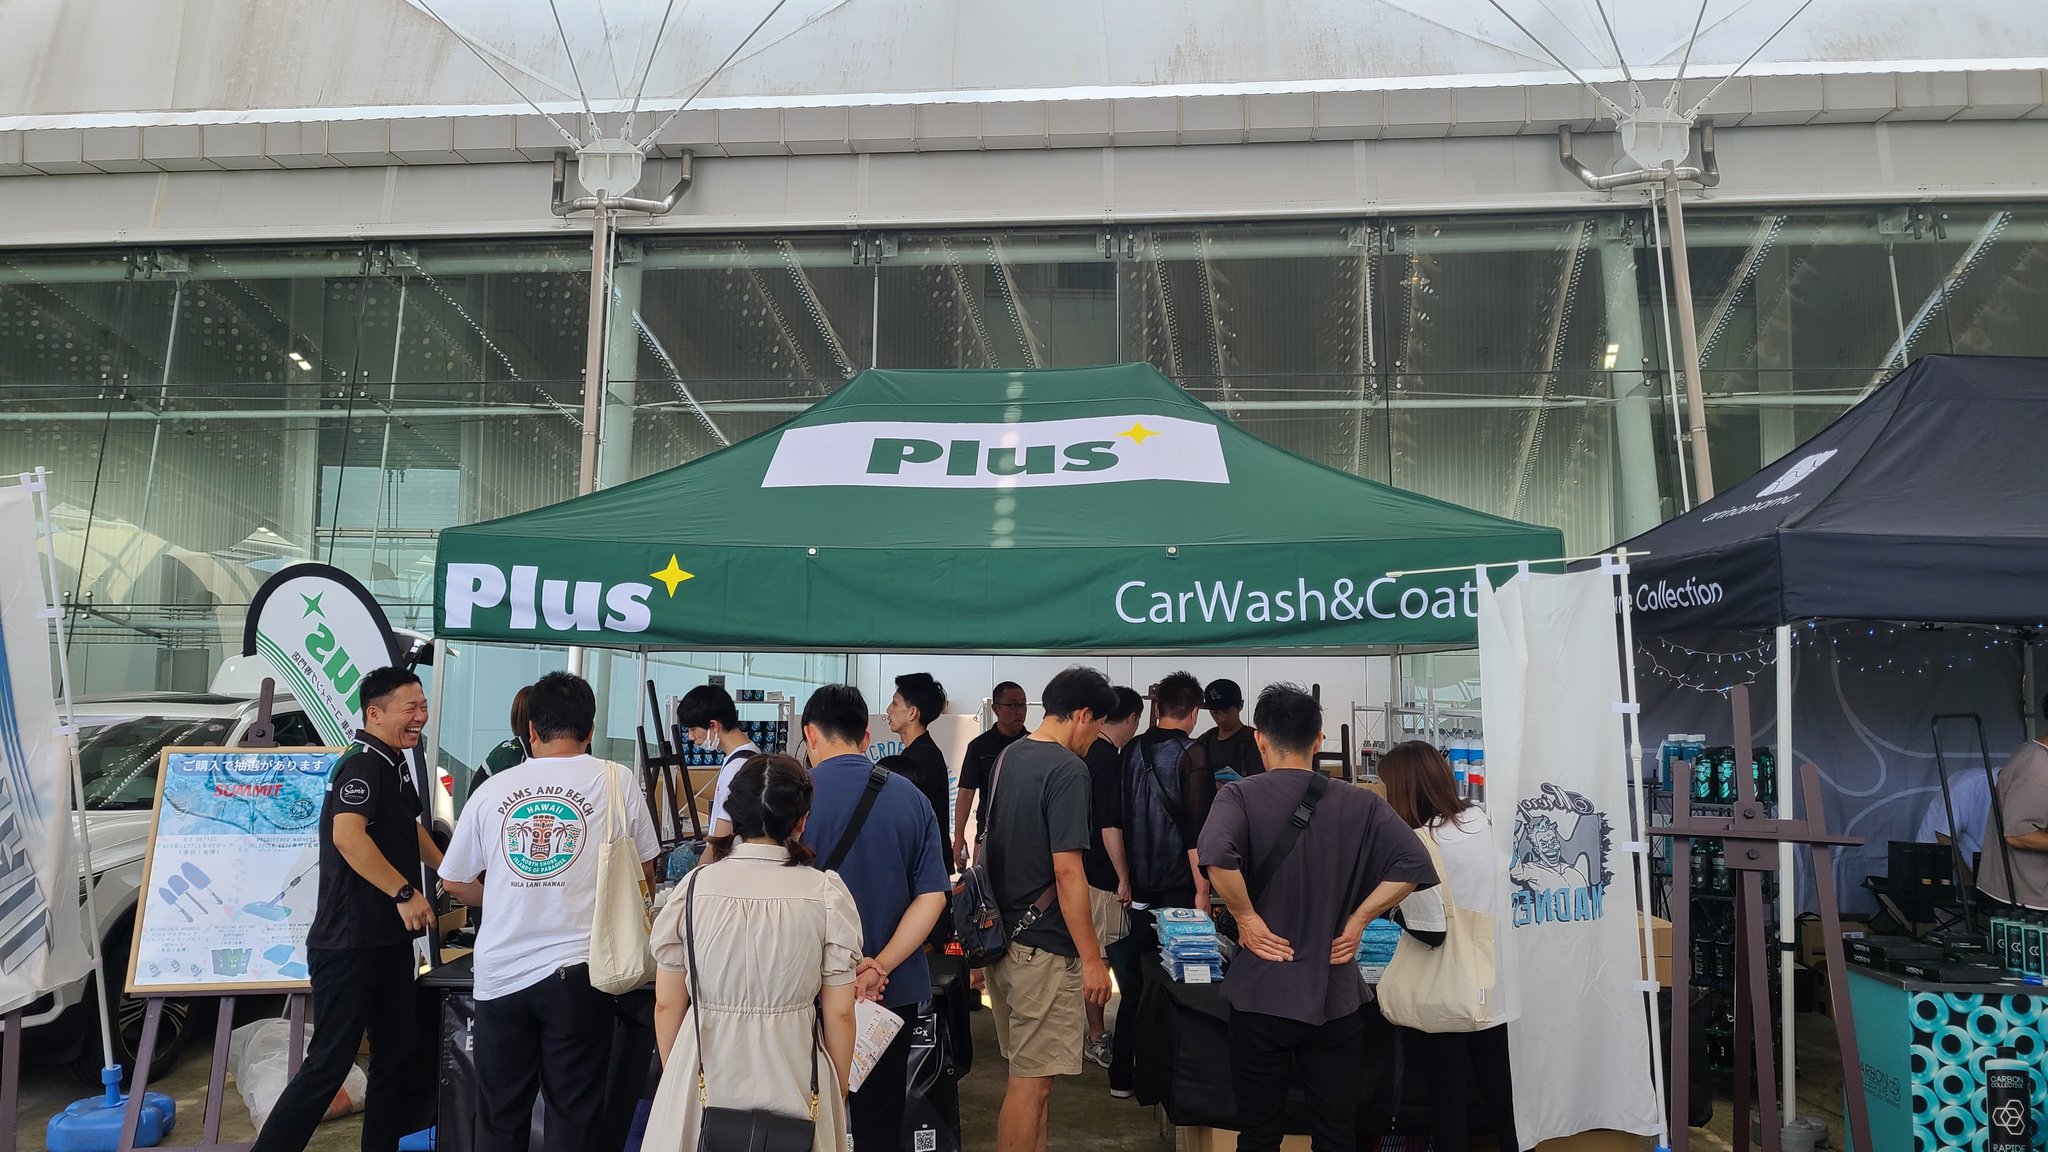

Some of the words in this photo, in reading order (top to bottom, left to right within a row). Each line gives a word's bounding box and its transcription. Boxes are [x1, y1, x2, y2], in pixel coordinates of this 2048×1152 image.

[866, 437, 1120, 477] Plus
[445, 562, 654, 633] Plus
[1636, 576, 1723, 612] Collection
[182, 759, 324, 773] ご購入で抽選があります
[212, 783, 284, 797] SUMMIT
[497, 787, 532, 815] PALMS
[536, 786, 563, 795] AND
[565, 788, 594, 817] BEACH
[526, 803, 564, 814] HAWAII
[513, 857, 532, 872] ISLANDS
[540, 857, 567, 873] PARADISE
[1990, 1075, 2024, 1083] CARBON
